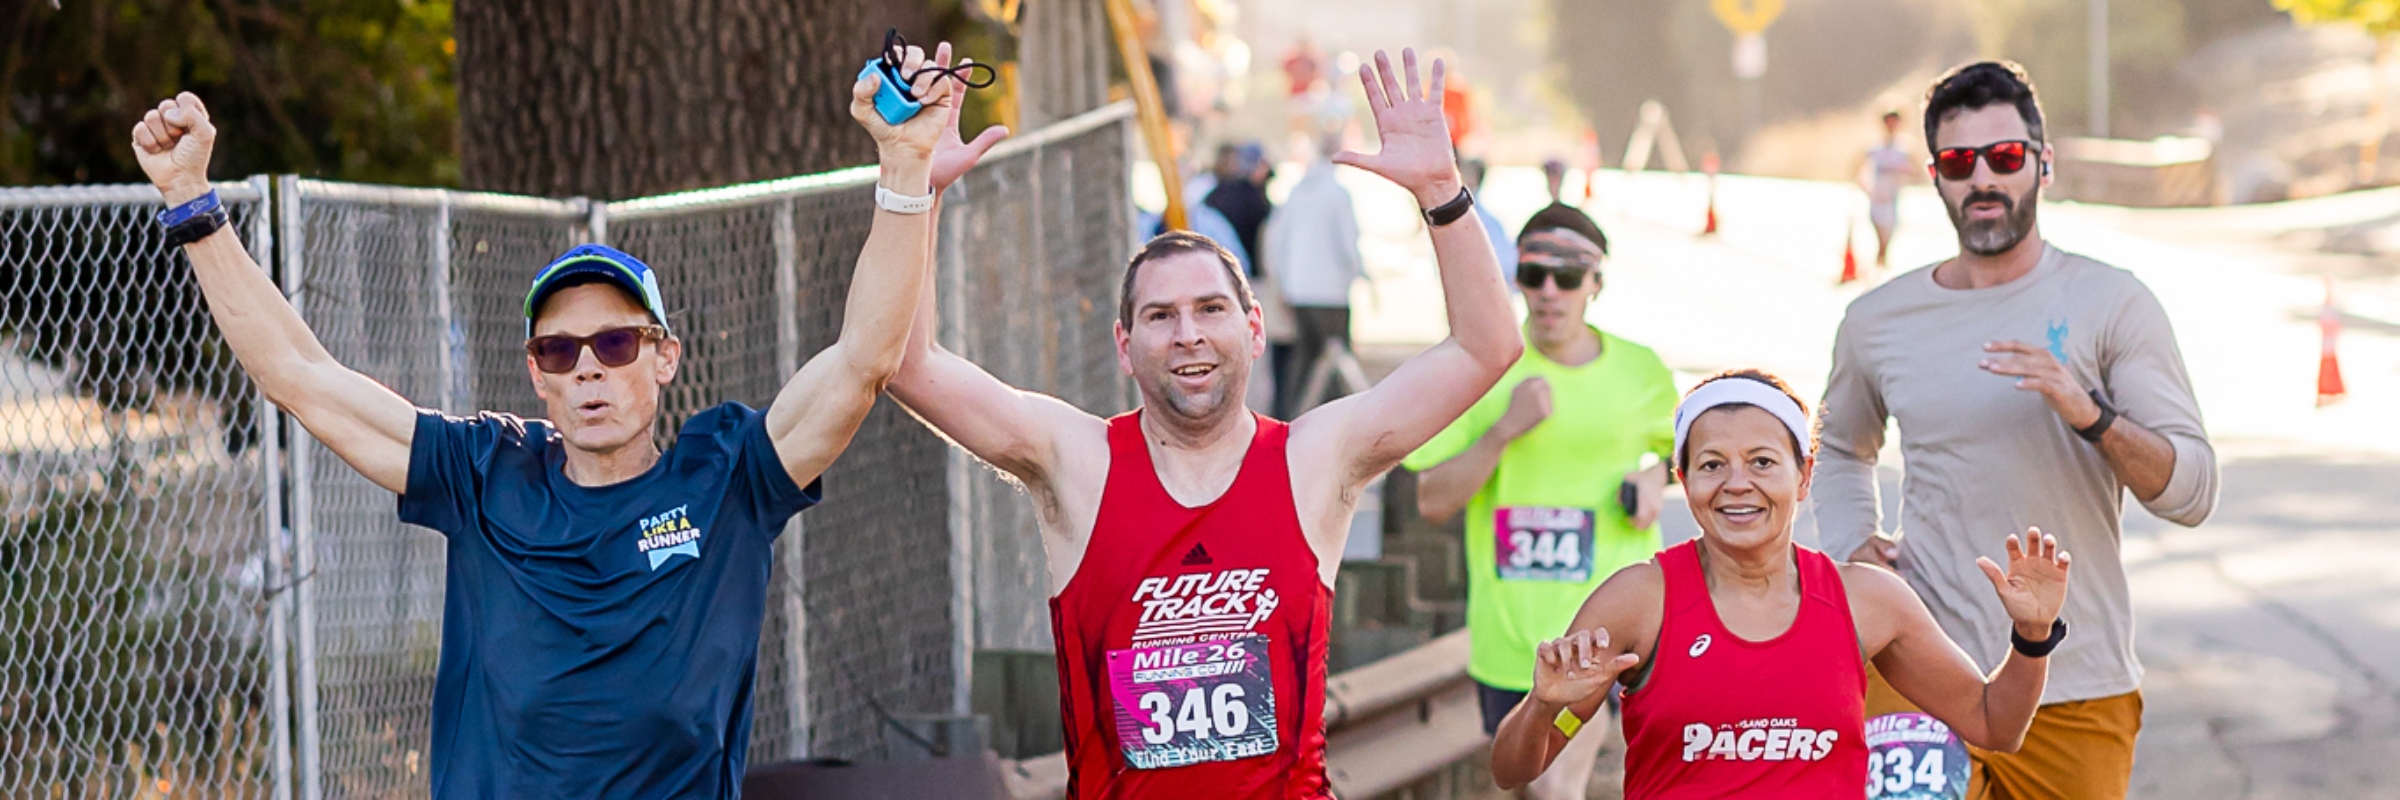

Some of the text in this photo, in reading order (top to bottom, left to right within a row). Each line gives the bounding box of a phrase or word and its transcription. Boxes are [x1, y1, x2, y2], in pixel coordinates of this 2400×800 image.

[639, 504, 687, 530] PARTY
[643, 518, 691, 538] LIKE A
[638, 528, 701, 552] RUNNER
[1509, 531, 1581, 568] 344
[1132, 568, 1270, 602] FUTURE
[1139, 592, 1256, 622] TRACK
[1131, 635, 1196, 650] RUNNING
[1133, 641, 1246, 670] Mile 26
[1135, 664, 1218, 681] RUNNING CO
[1139, 683, 1249, 745] 346
[1770, 718, 1798, 728] OAKS
[1682, 722, 1839, 762] PACERS
[1865, 747, 1947, 798] 334
